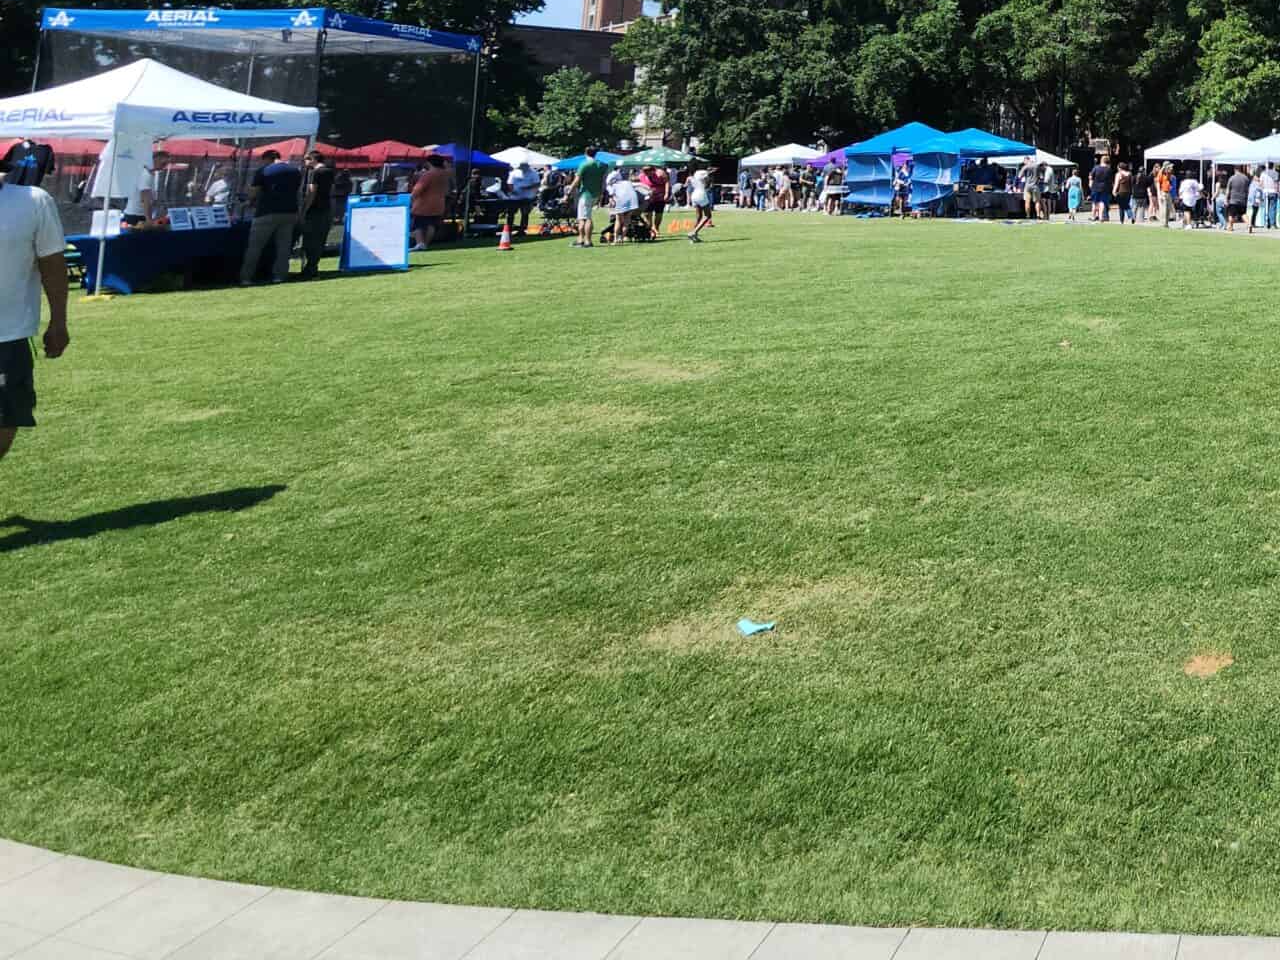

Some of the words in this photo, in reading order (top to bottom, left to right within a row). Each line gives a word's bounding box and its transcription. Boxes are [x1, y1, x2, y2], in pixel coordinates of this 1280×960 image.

[145, 9, 220, 22] AERIAL
[392, 23, 432, 38] AERIAL
[172, 111, 275, 124] AERIAL
